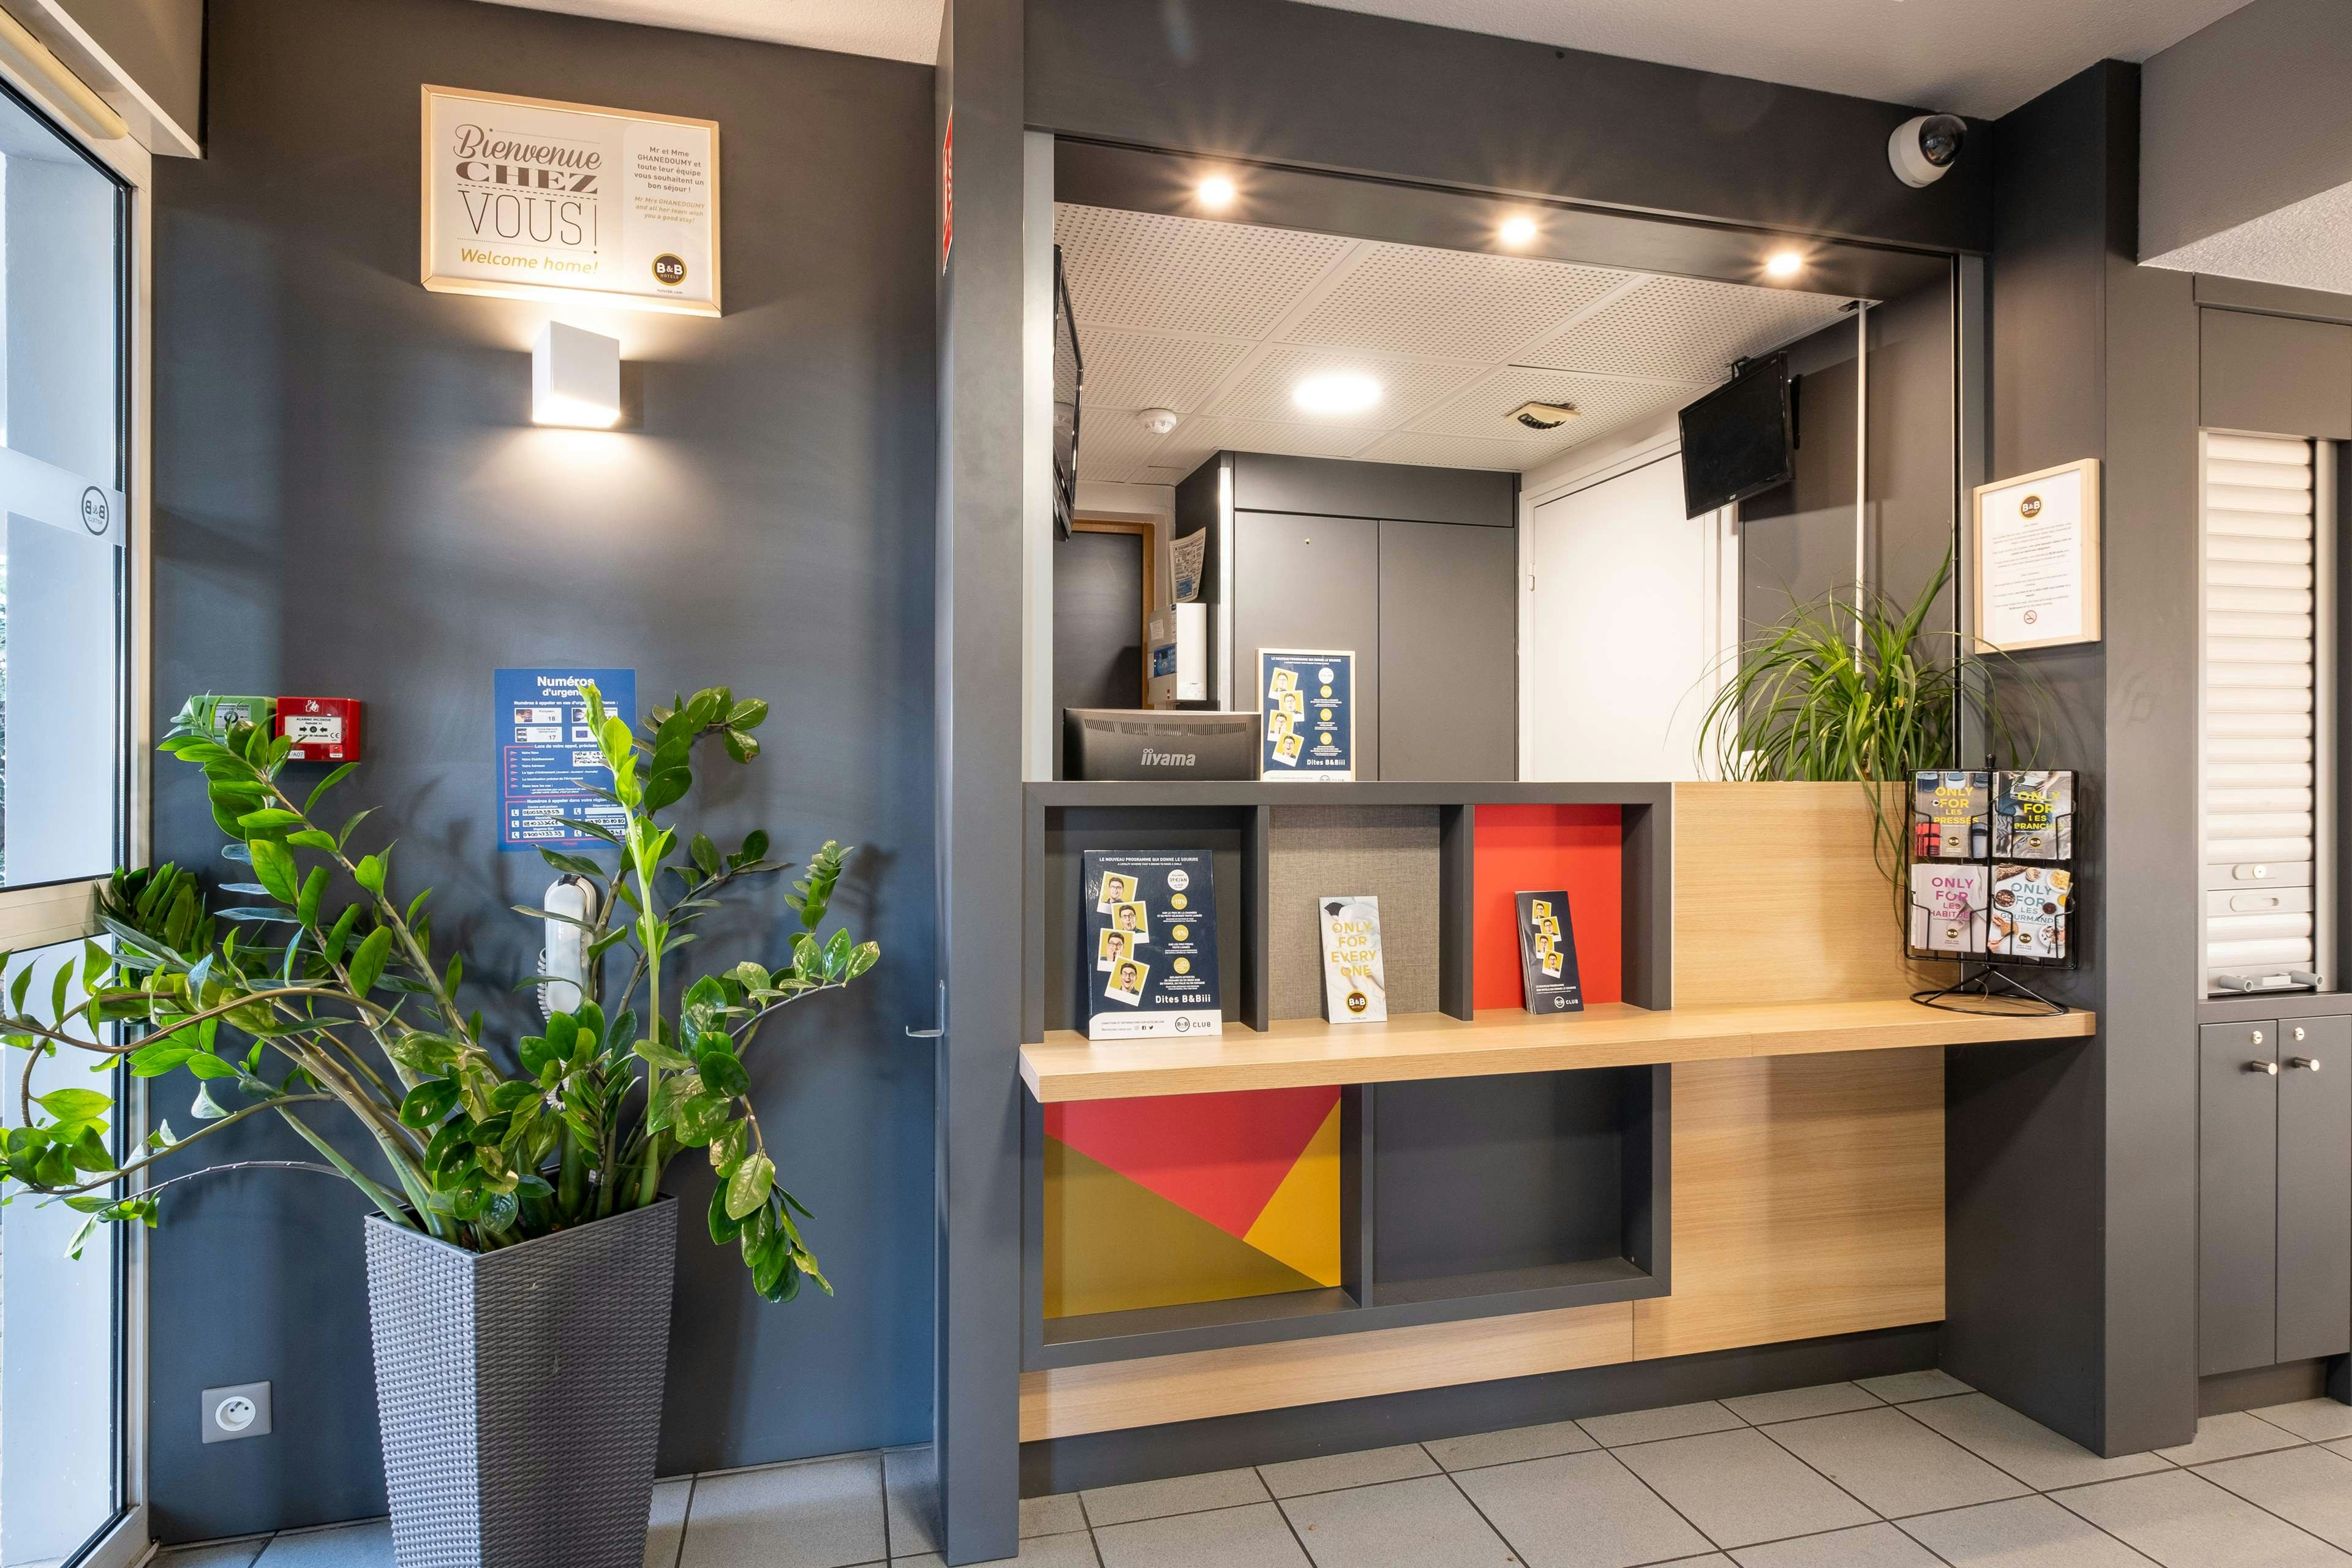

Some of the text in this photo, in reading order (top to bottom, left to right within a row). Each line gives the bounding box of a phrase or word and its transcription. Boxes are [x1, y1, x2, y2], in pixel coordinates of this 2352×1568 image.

[453, 124, 602, 170] Bienvenue
[638, 154, 692, 166] GHANEDOUMY
[456, 161, 598, 194] CHEZ
[676, 167, 701, 176] équipe
[654, 175, 693, 184] souhaitent
[659, 198, 705, 209] GHANEDOUMY
[458, 190, 598, 254] VOUS!
[461, 248, 598, 274] Welcome home!
[657, 262, 683, 275] B&B
[2022, 500, 2040, 512] B&B
[537, 676, 595, 687] Numéros
[1140, 748, 1196, 766] iiyama
[1935, 786, 1974, 797] ONLY
[2018, 791, 2061, 802] ONLY
[1939, 798, 1969, 808] FOR
[2024, 803, 2054, 814] FOR
[1932, 877, 1974, 888] ONLY
[2011, 883, 2052, 895] ONLY
[1936, 891, 1968, 902] FOR
[2016, 895, 2046, 907] FOR
[2000, 913, 2059, 924] GOURMANDS
[1332, 921, 1371, 933] ONLY
[1339, 936, 1367, 948] FOR
[1331, 951, 1377, 963] EVERY
[1340, 965, 1371, 977] ONE
[1182, 994, 1211, 1003] B&Biii
